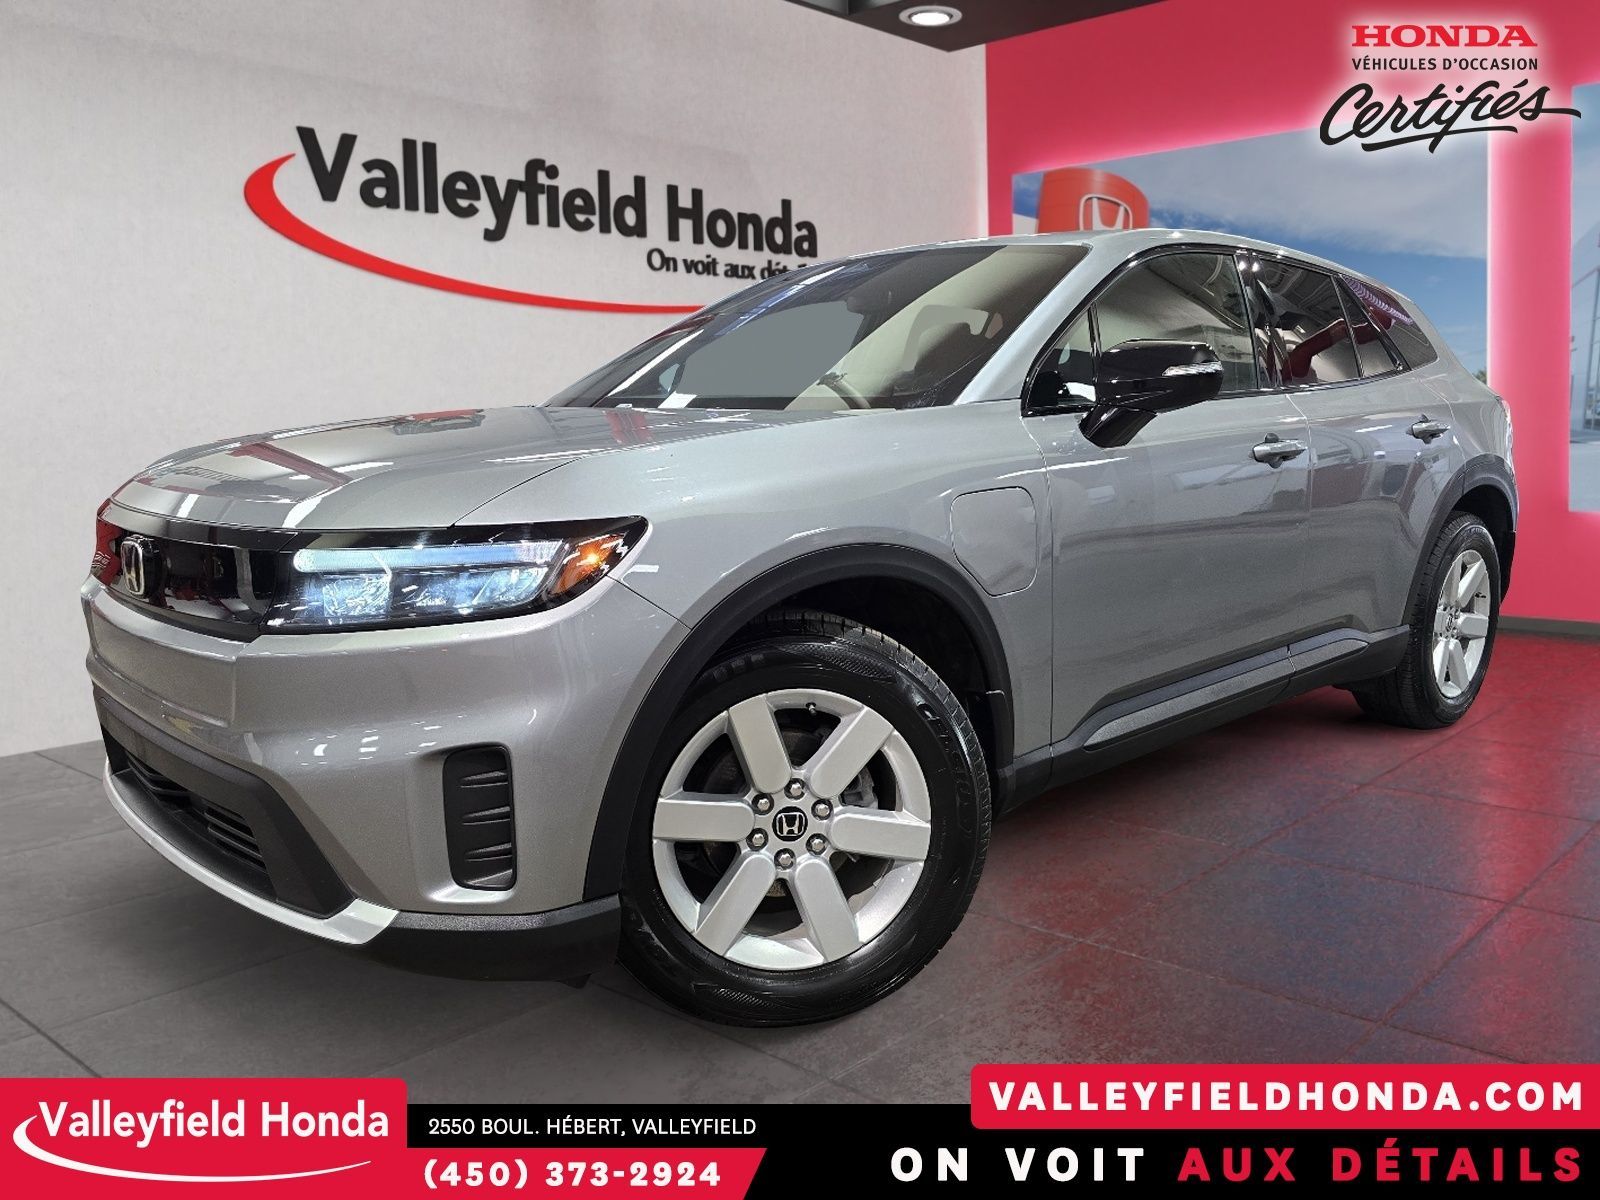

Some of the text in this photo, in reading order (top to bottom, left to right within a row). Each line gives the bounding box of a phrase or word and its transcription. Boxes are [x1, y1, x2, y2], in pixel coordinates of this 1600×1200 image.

[296, 126, 818, 258] Valleyfield Honda
[646, 247, 678, 273] On
[682, 254, 719, 277] voit
[723, 262, 757, 280] aux
